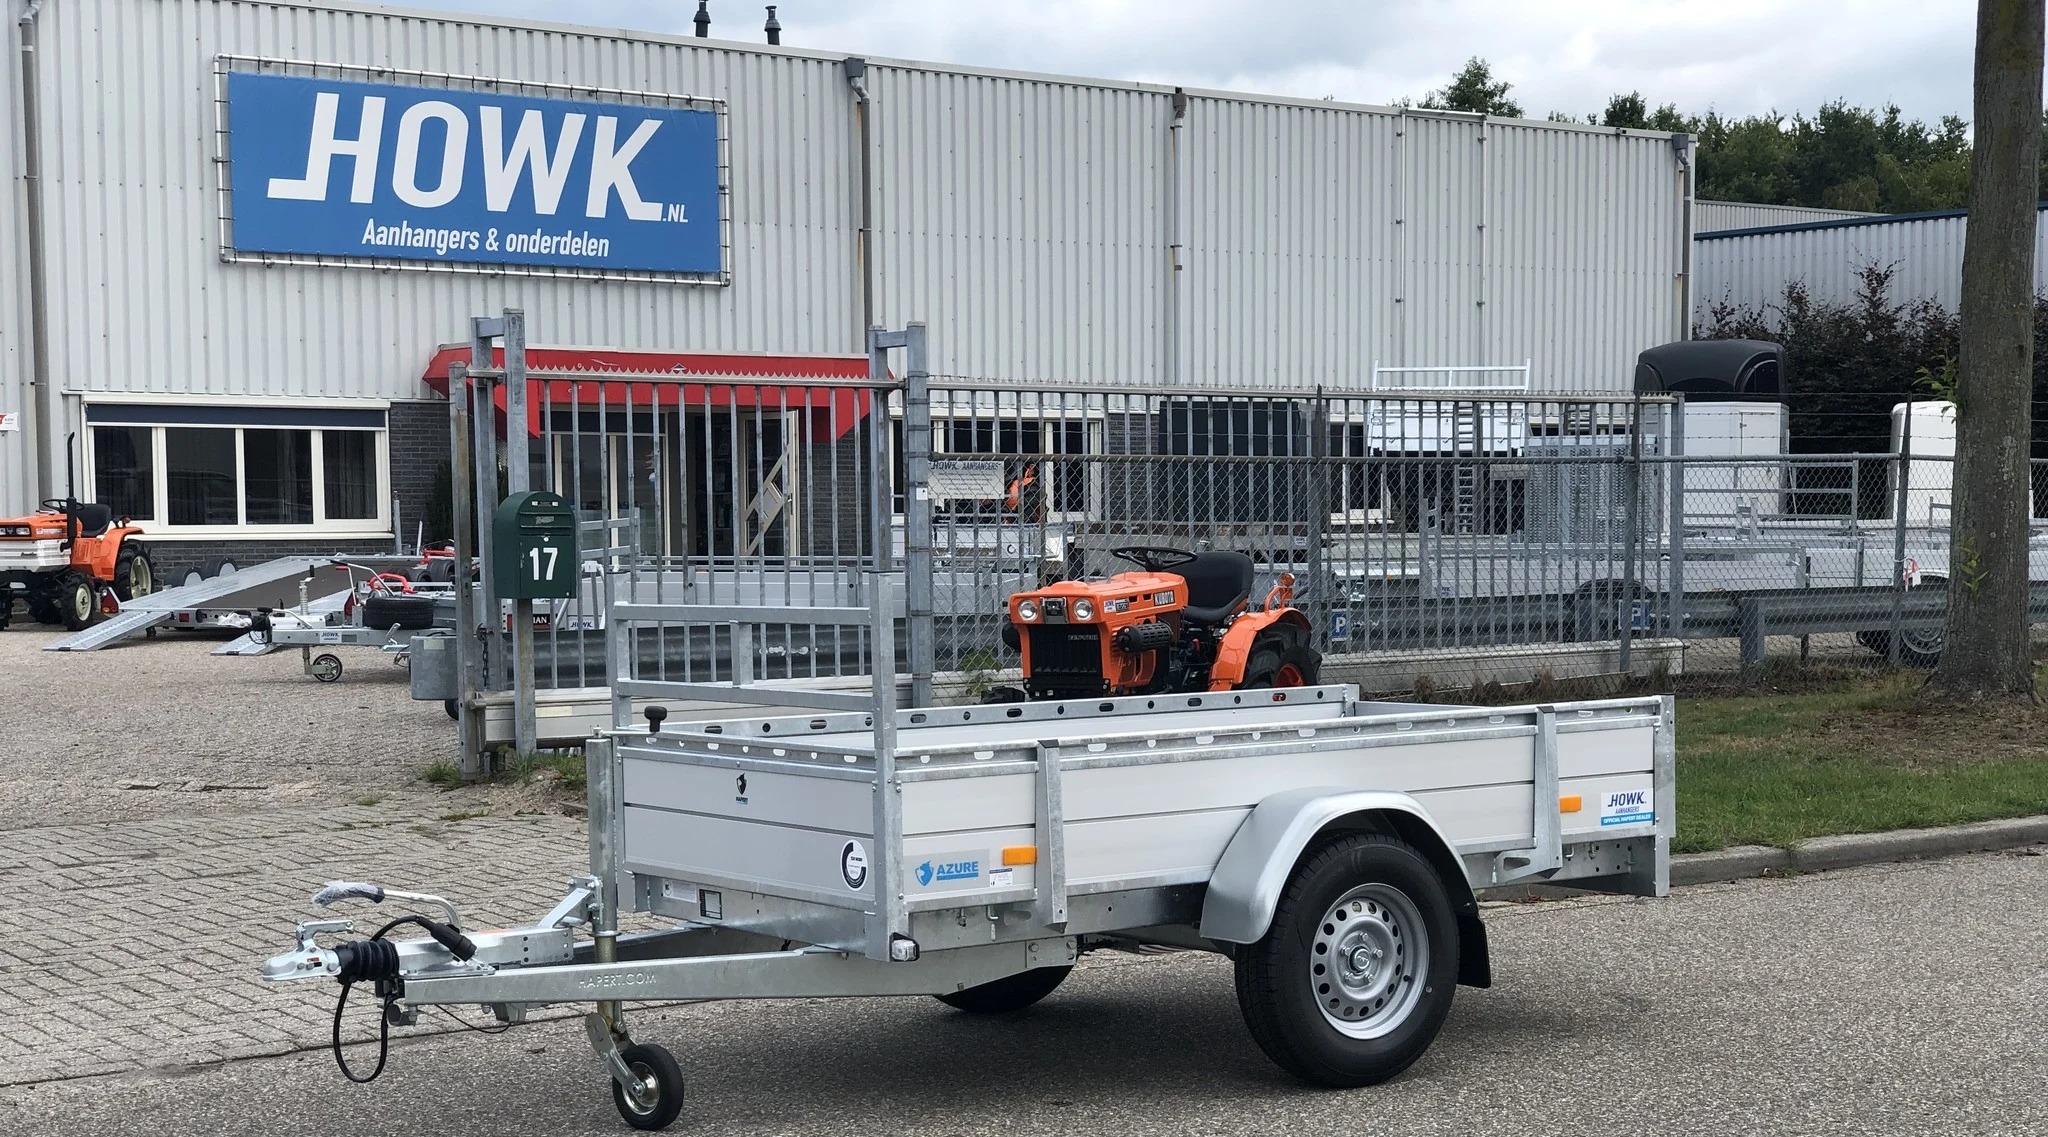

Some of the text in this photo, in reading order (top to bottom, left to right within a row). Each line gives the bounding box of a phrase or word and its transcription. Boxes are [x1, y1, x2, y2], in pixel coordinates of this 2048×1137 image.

[361, 217, 610, 257] Aanhangers & onderdelen
[529, 547, 558, 581] 17
[1335, 616, 1346, 633] P
[936, 861, 979, 875] AZURE
[578, 971, 657, 989] HAPERT.COM
